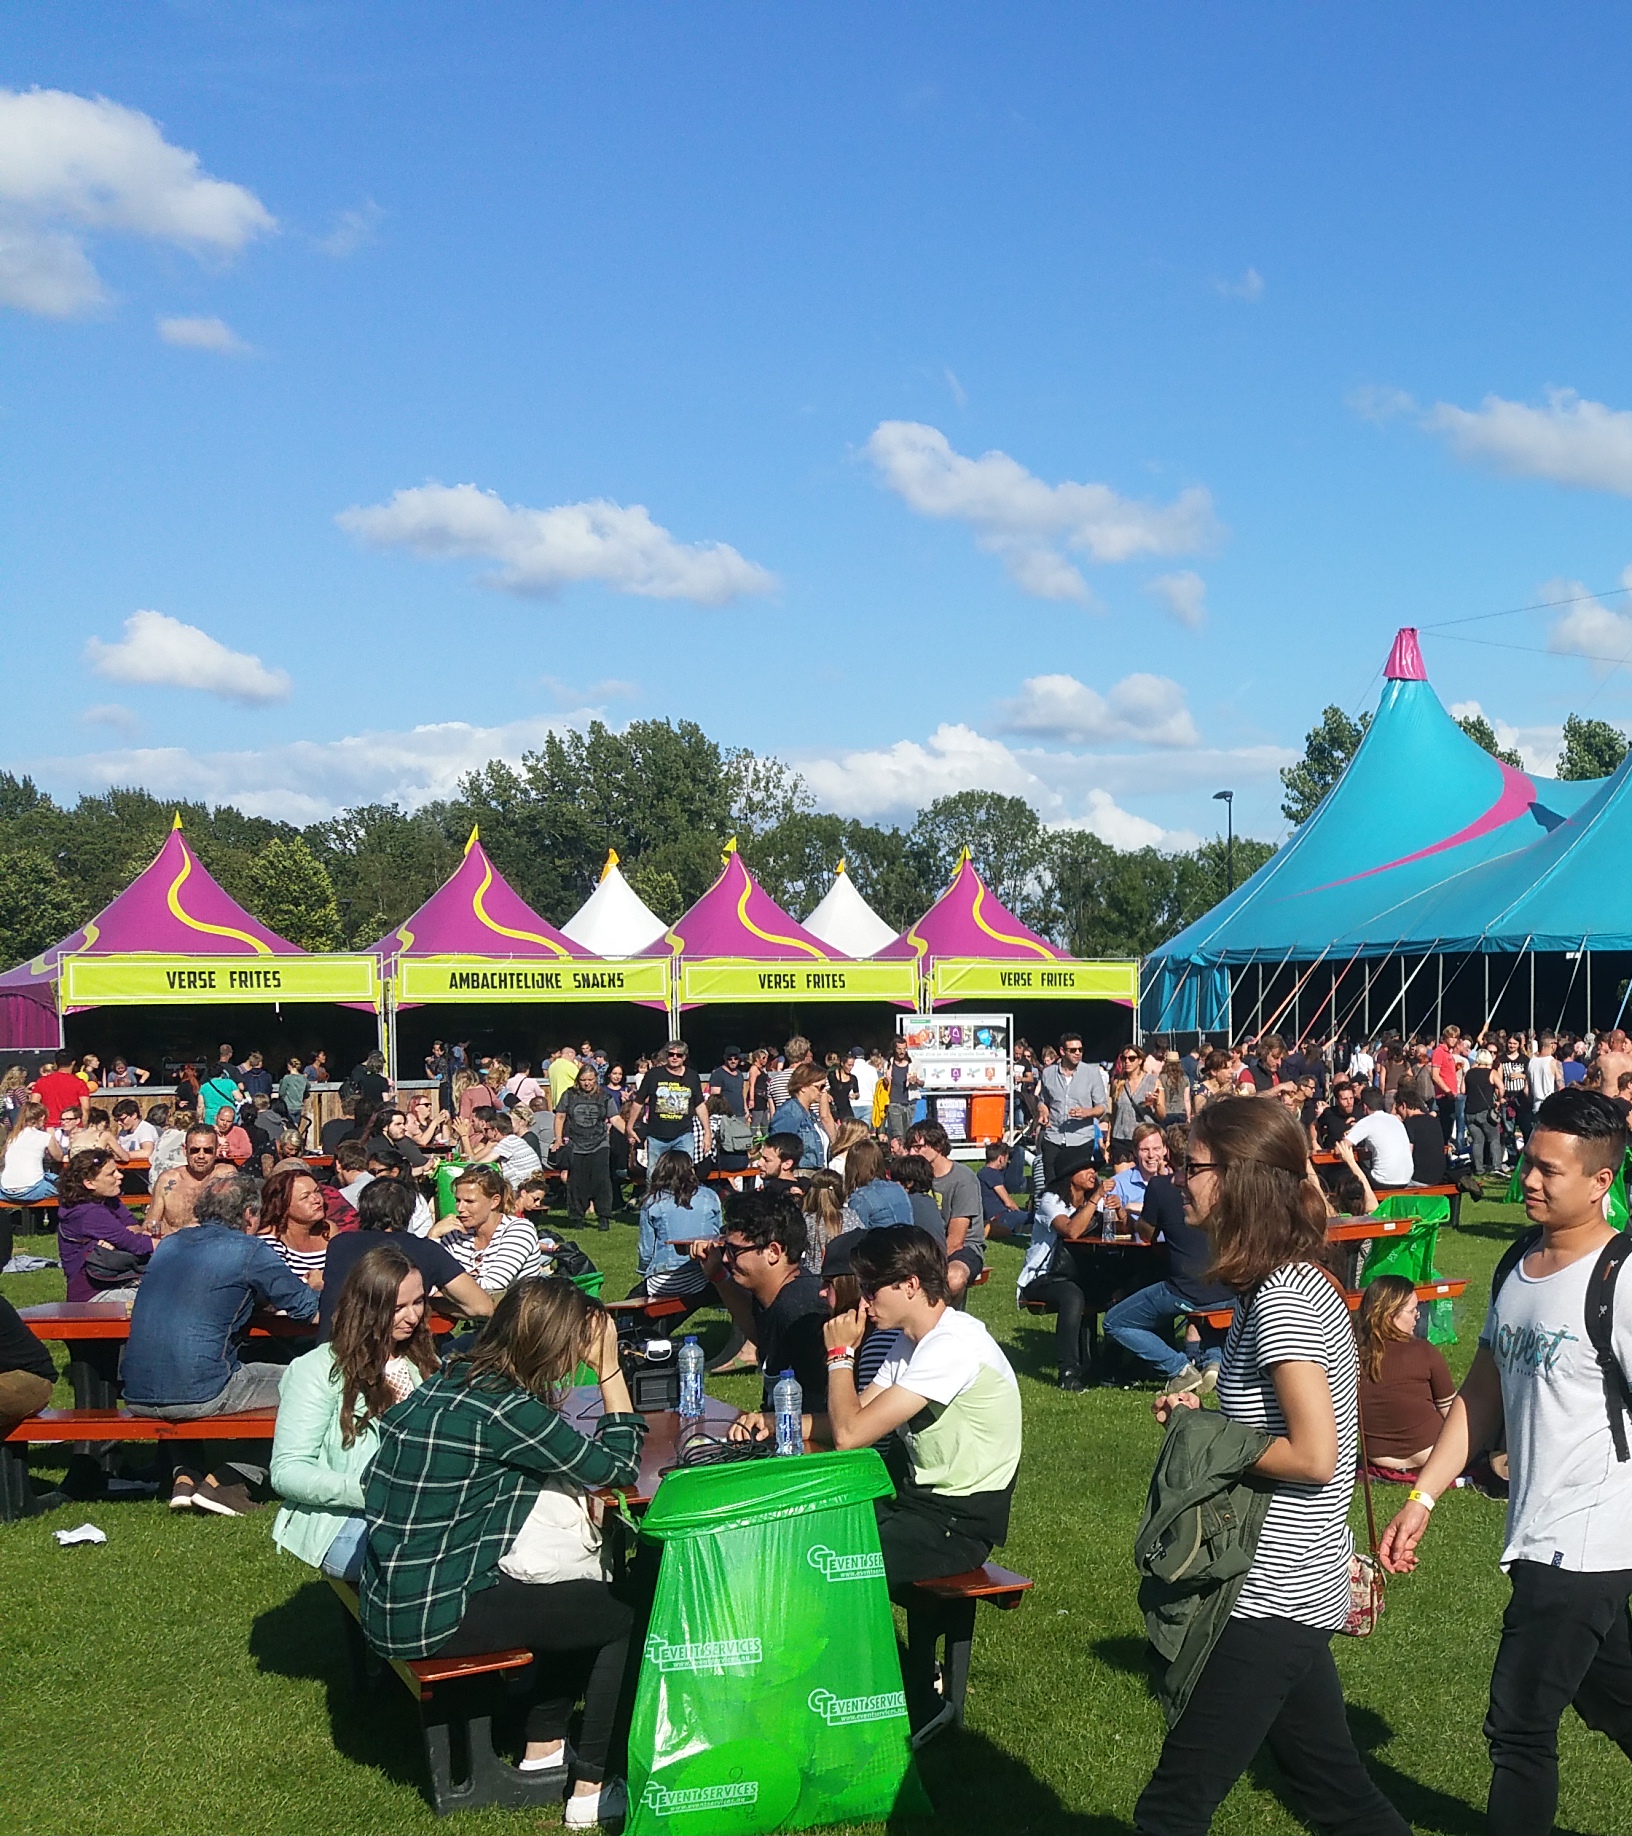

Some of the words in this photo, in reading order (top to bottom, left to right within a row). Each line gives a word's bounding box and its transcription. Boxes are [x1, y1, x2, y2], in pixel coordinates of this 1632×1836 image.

[166, 971, 217, 989] VERSE
[229, 970, 282, 989] FRITES
[449, 972, 562, 989] AMBACHTELIJKE
[573, 972, 625, 989] SNACKS
[758, 973, 797, 989] VERSE
[806, 973, 846, 989] FRITES
[1000, 971, 1033, 987] VERSE
[1041, 972, 1075, 987] FRITES
[829, 1556, 866, 1571] EVENT
[829, 1699, 866, 1715] EVENT
[702, 1783, 757, 1800] SERVICES
